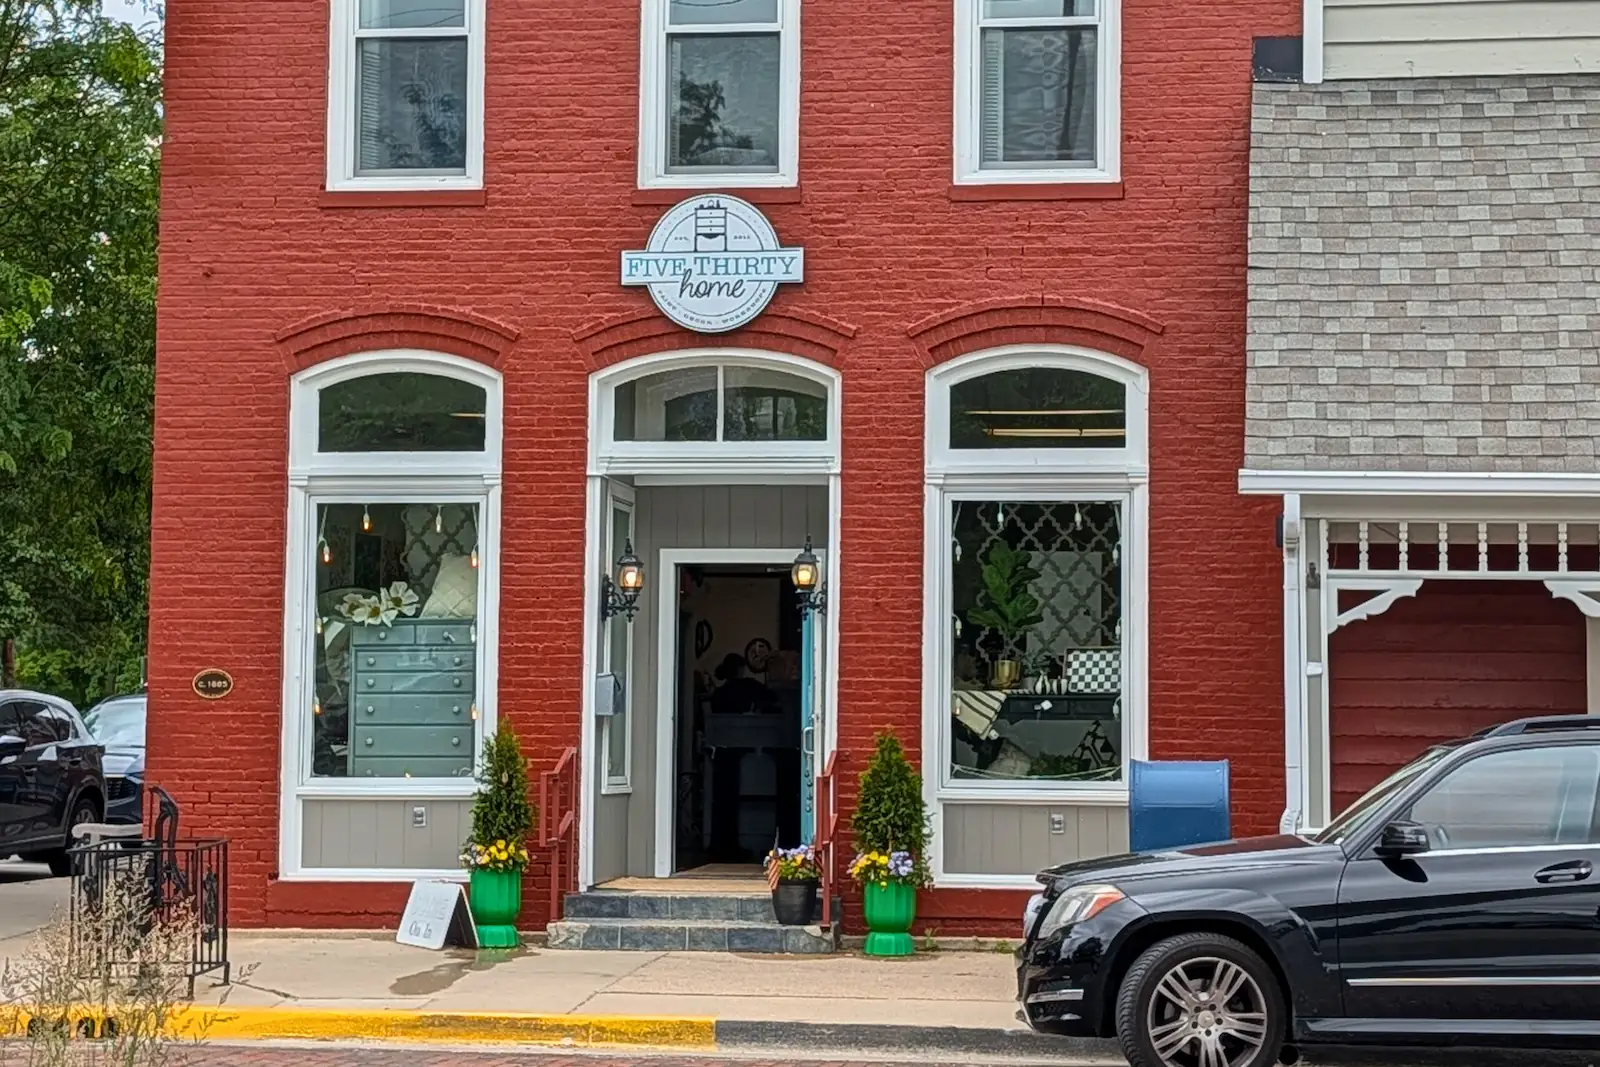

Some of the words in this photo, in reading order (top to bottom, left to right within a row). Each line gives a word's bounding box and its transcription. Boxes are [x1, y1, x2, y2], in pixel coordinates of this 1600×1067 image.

[625, 257, 686, 277] FIVE
[694, 256, 798, 276] THIRTY
[678, 268, 747, 299] home
